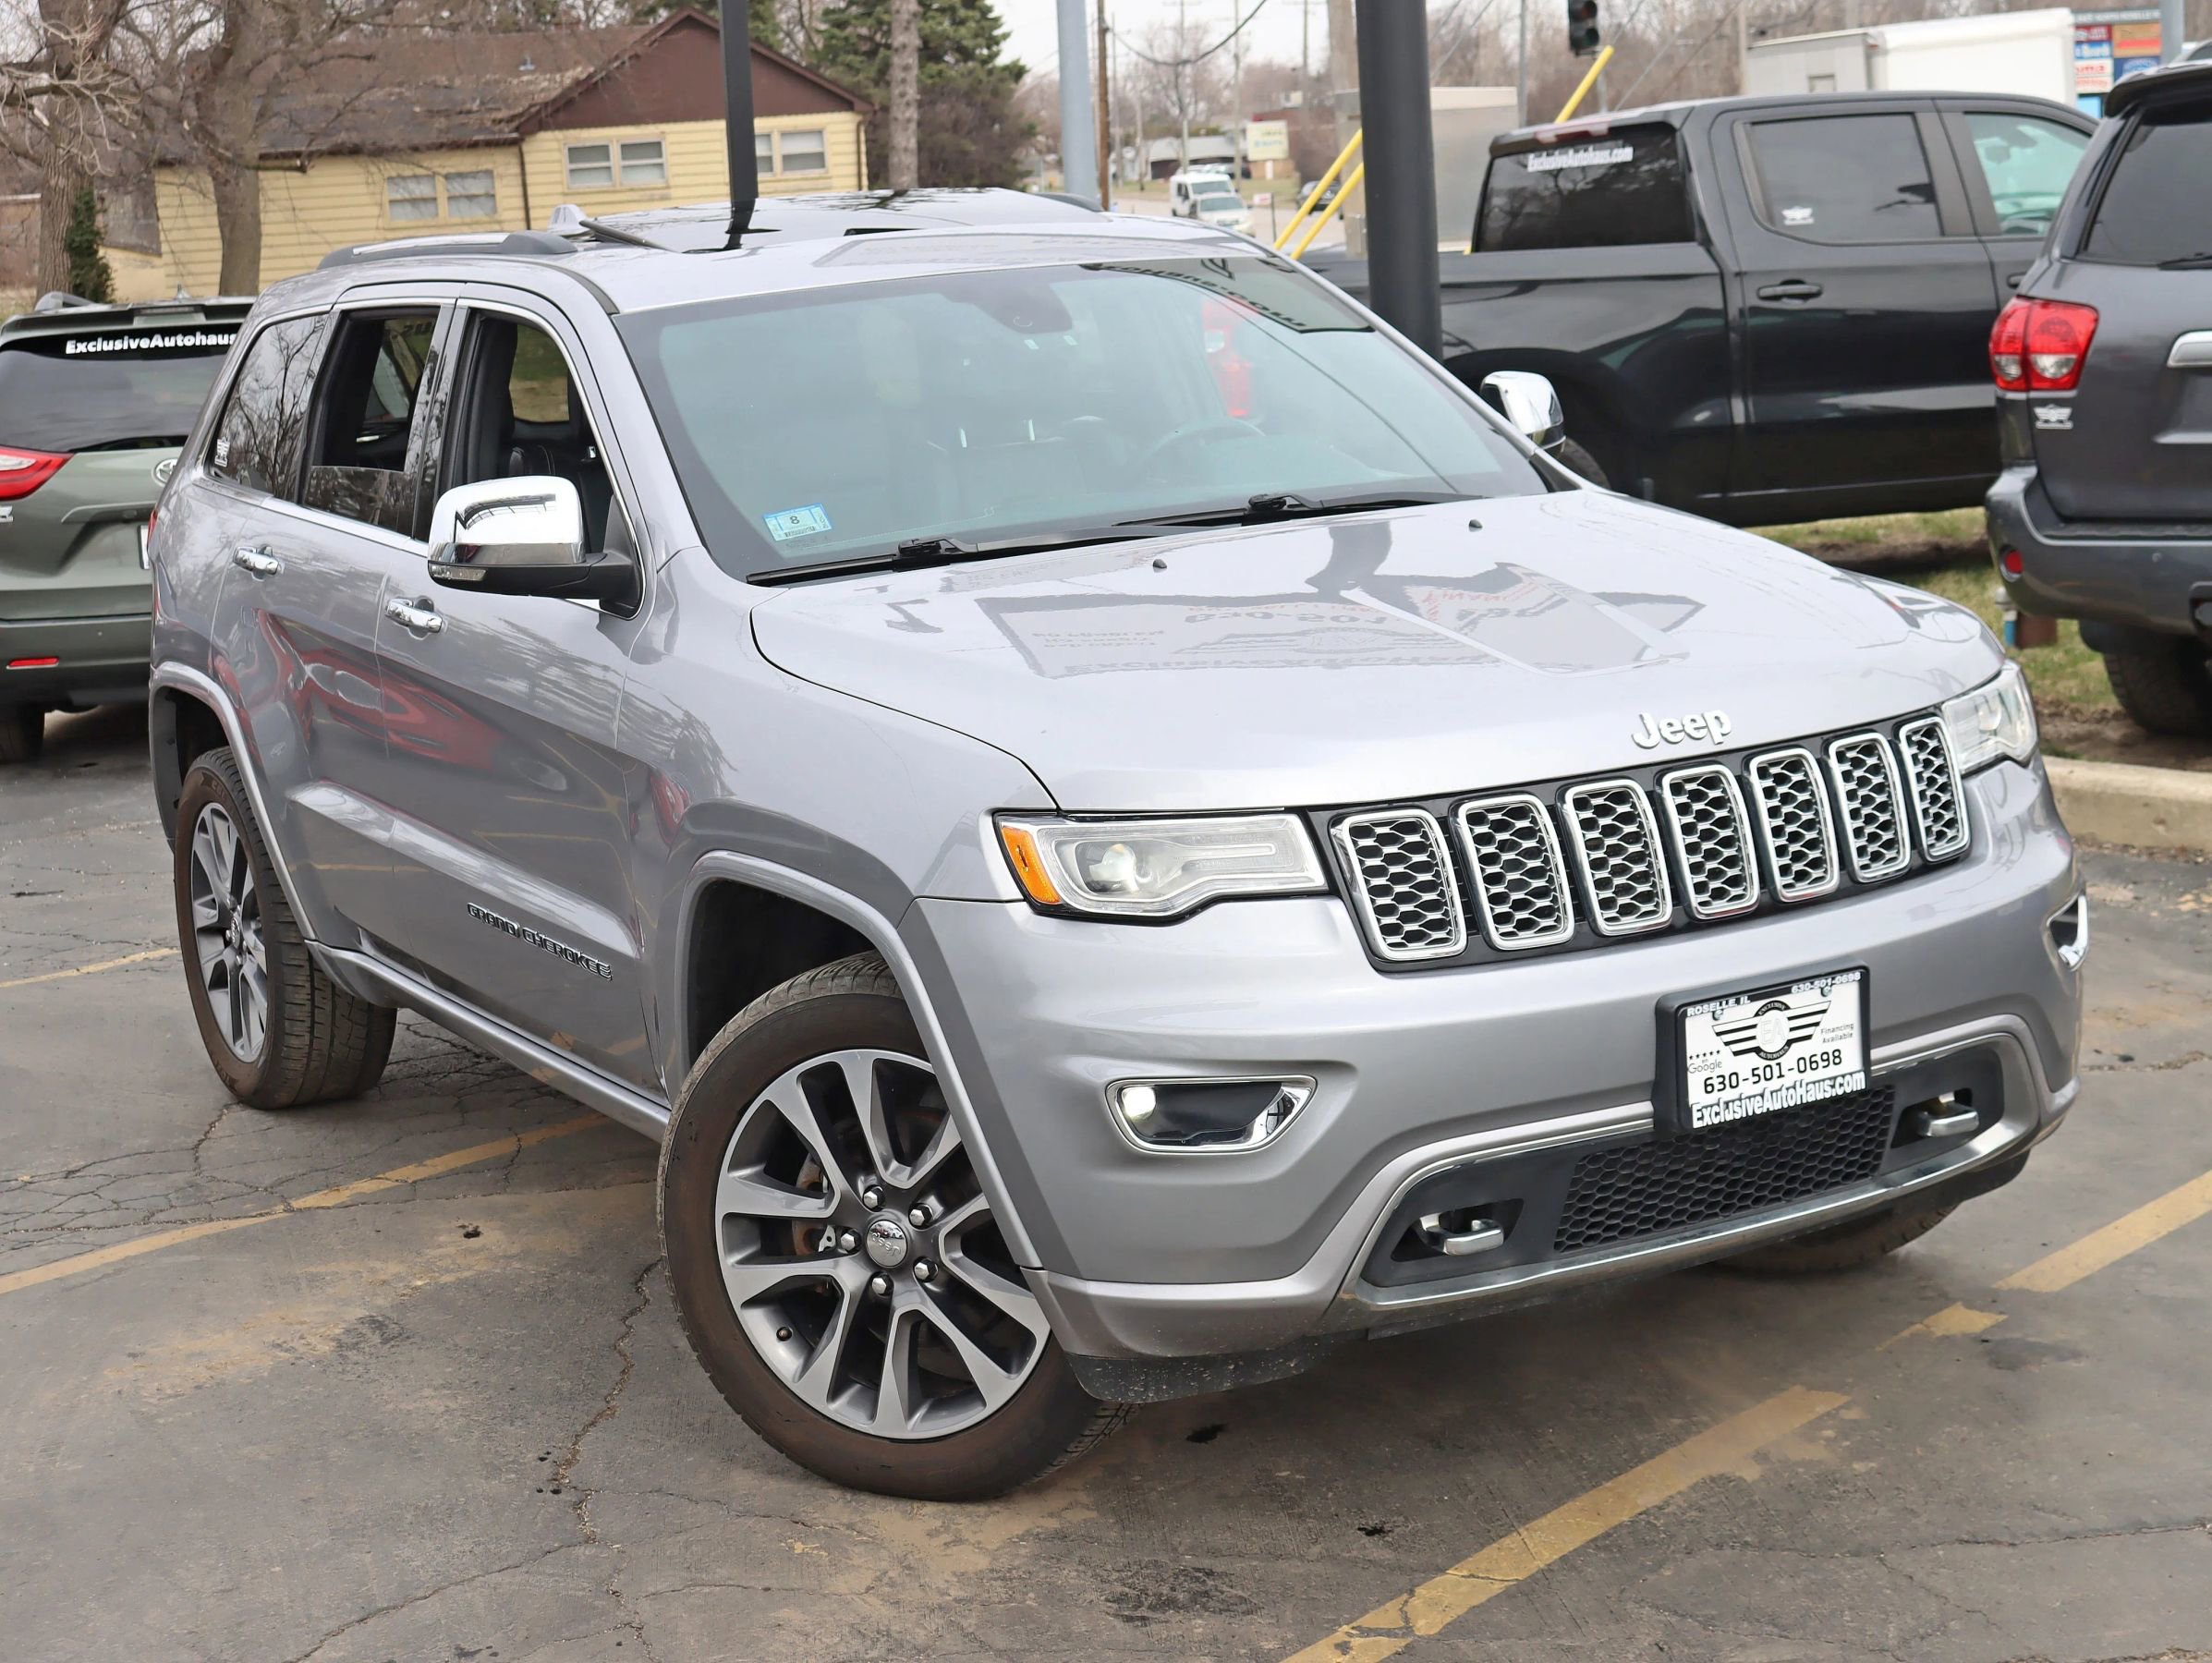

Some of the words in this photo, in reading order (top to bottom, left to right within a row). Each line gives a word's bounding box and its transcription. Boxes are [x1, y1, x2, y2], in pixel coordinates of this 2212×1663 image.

[790, 516, 799, 524] 8
[1631, 710, 1732, 749] Jeep
[467, 902, 520, 938] GRAND
[522, 927, 613, 981] CHEROKEE
[1791, 972, 1862, 994] 630-501-0698
[1740, 996, 1751, 1006] IL
[1820, 1024, 1854, 1035] Financing
[1823, 1033, 1853, 1044] Available
[1687, 1059, 1723, 1074] Google
[1704, 1049, 1842, 1095] 630-501-0698
[1692, 1071, 1866, 1129] ExclusiveAutoHaus.com
